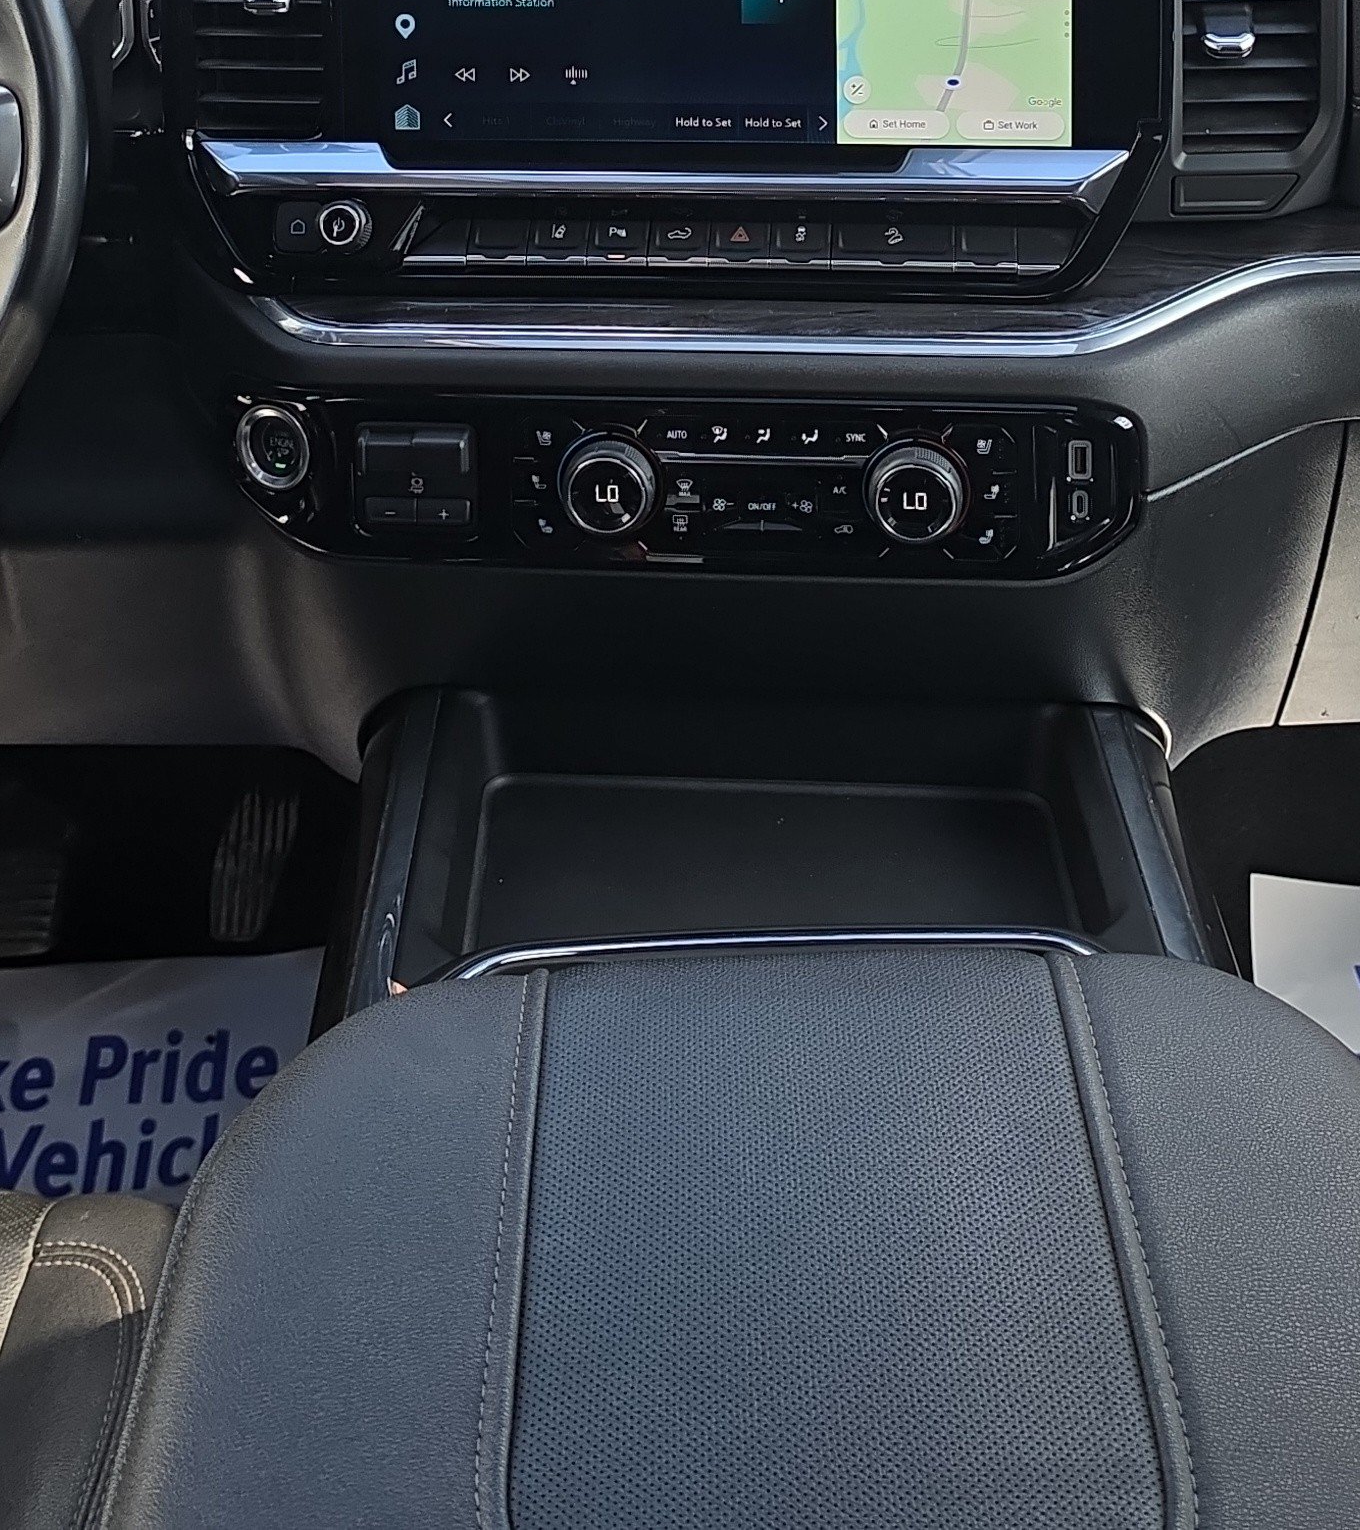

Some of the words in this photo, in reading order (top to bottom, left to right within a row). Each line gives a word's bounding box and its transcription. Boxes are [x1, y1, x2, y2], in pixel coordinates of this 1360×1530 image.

[1028, 96, 1063, 109] Google
[675, 117, 700, 129] Hold
[701, 118, 713, 129] to
[714, 117, 732, 129] Set
[744, 118, 770, 129] Hold
[772, 118, 783, 129] to
[785, 118, 802, 129] Set
[882, 119, 898, 129] Set
[899, 119, 926, 129] Home
[997, 119, 1013, 130] Set
[1015, 119, 1038, 130] Work
[666, 430, 688, 440] AUTO
[845, 432, 866, 443] SYNC
[832, 485, 847, 495] A/C
[747, 502, 777, 512] ON/OFF
[79, 1029, 279, 1106] Pride
